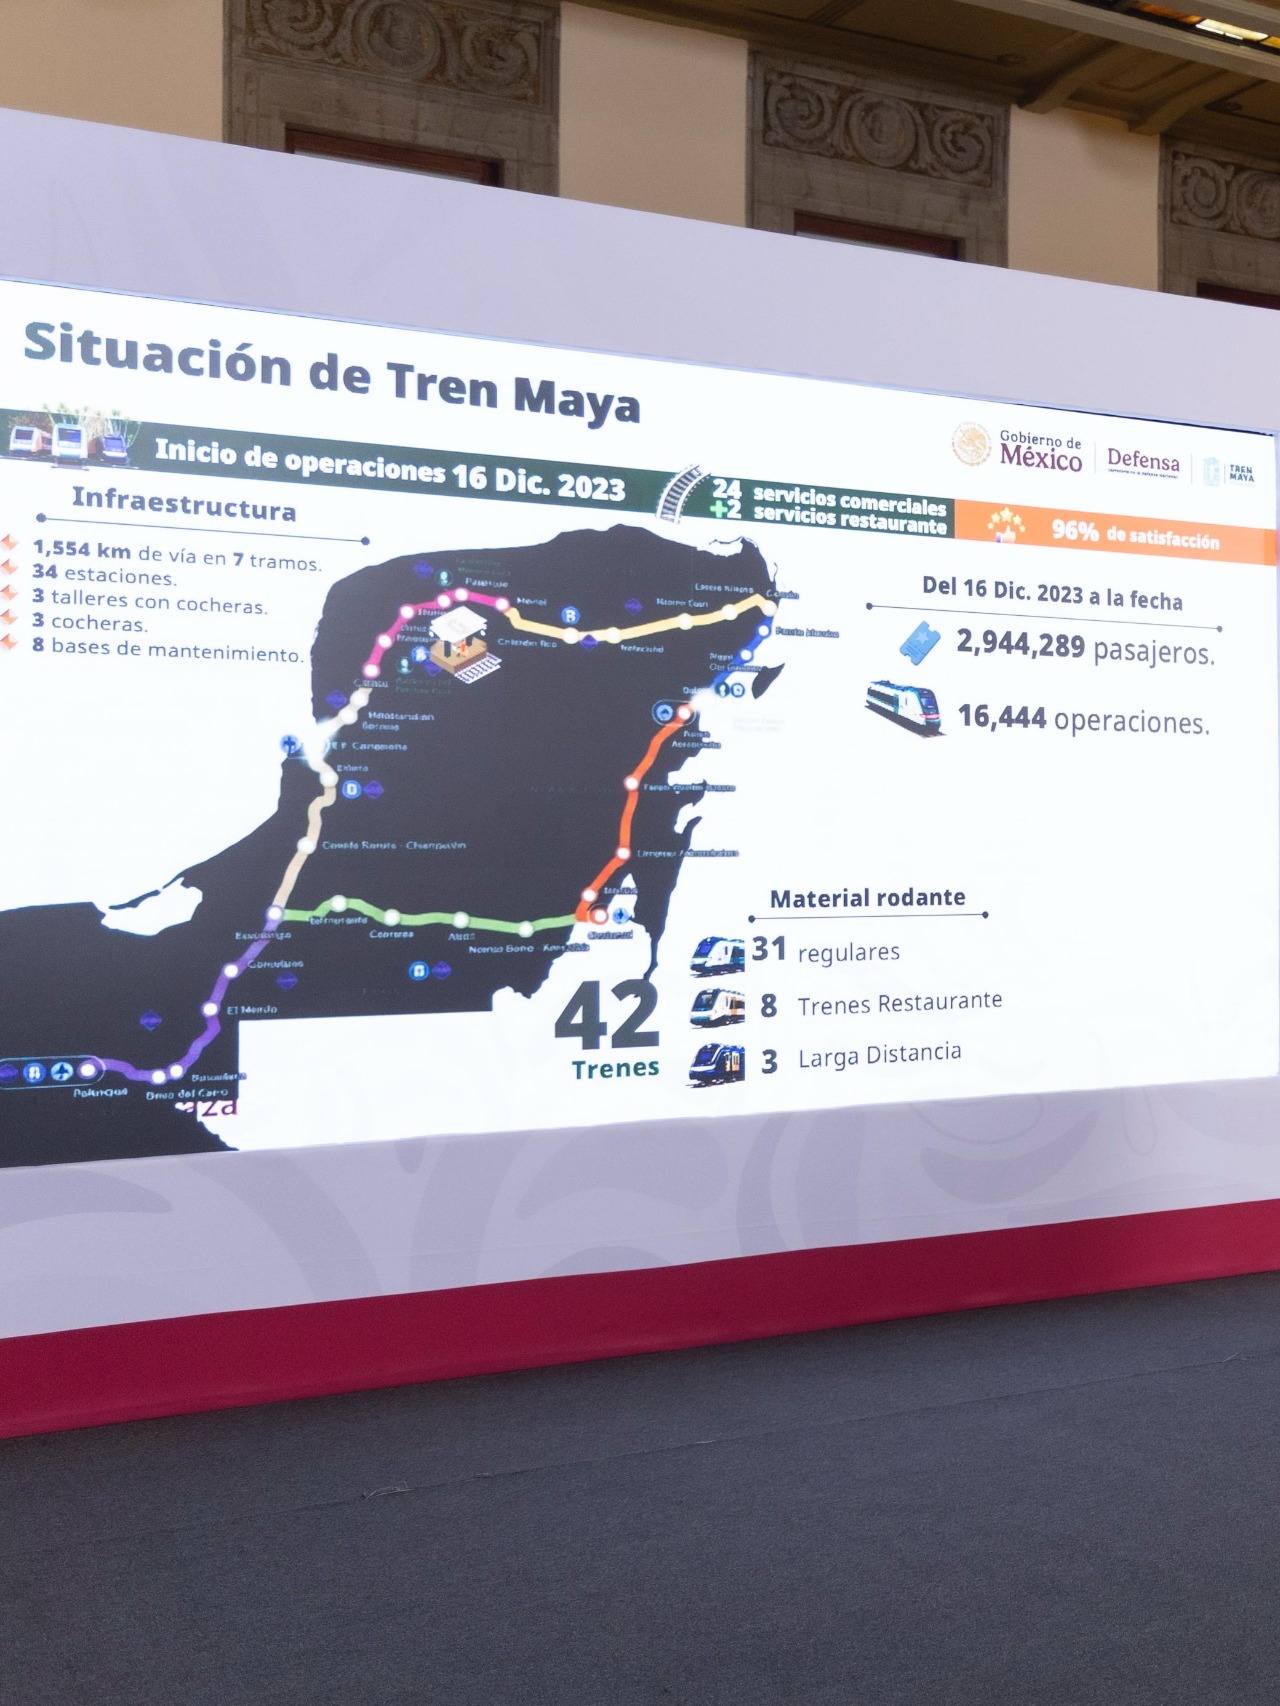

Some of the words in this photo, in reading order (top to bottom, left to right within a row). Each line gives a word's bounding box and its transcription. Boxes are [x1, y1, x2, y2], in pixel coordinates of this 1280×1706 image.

[24, 321, 291, 386] Situación
[309, 352, 370, 394] de
[387, 362, 497, 408] Tren
[515, 377, 640, 430] Maya
[1000, 430, 1062, 448] Gobierno
[1067, 436, 1082, 450] de
[155, 437, 237, 465] Inicio
[244, 445, 278, 469] de
[285, 453, 446, 484] operaciones
[452, 464, 487, 490] 16
[496, 468, 550, 495] Dic.
[558, 474, 626, 502] 2023
[1000, 443, 1083, 473] México
[1108, 448, 1180, 472] Defensa
[1230, 464, 1253, 474] TREN
[1229, 473, 1255, 483] MAYA
[73, 485, 297, 522] Infraestructura
[713, 478, 742, 499] 24
[753, 485, 836, 507] servicios
[840, 495, 947, 517] comerciales
[753, 504, 836, 526] servicios
[841, 515, 948, 535] restaurante
[1051, 518, 1100, 542] 96%
[1107, 526, 1126, 541] de
[1129, 528, 1220, 551] satisfacción
[34, 539, 90, 557] 1,554
[97, 542, 131, 560] km
[138, 545, 162, 562] de
[168, 548, 196, 564] vía
[203, 552, 226, 565] en
[233, 552, 244, 566] 7
[250, 555, 323, 572] tramos.
[32, 563, 58, 579] 34
[65, 567, 178, 586] estaciones.
[32, 588, 45, 603] 3
[52, 589, 128, 607] talleres
[135, 595, 170, 610] con
[177, 596, 269, 615] cocheras.
[923, 576, 957, 595] Del
[964, 579, 987, 597] 16
[994, 581, 1031, 601] Dic.
[1037, 584, 1084, 604] 2023
[1089, 590, 1100, 605] a
[1107, 588, 1124, 607] la
[1130, 590, 1183, 611] fecha
[32, 612, 45, 627] 3
[52, 613, 149, 633] cocheras.
[32, 636, 45, 652] 8
[52, 637, 110, 655] bases
[117, 640, 141, 656] de
[149, 642, 304, 663] mantenimiento.
[957, 628, 1085, 659] 2,944,289
[1094, 639, 1215, 669] pasajeros.
[958, 703, 1047, 732] 16,444
[1055, 709, 1210, 737] operaciones.
[770, 889, 870, 908] Material
[876, 889, 966, 907] rodante
[752, 935, 786, 961] 31
[798, 942, 900, 968] regulares
[554, 979, 660, 1050] 42
[760, 993, 778, 1017] 8
[798, 996, 871, 1016] Trenes
[878, 991, 1003, 1013] Restaurante
[572, 1059, 659, 1079] Trenes
[761, 1049, 778, 1074] 3
[800, 1048, 860, 1072] Larga
[867, 1040, 962, 1065] Distancia
